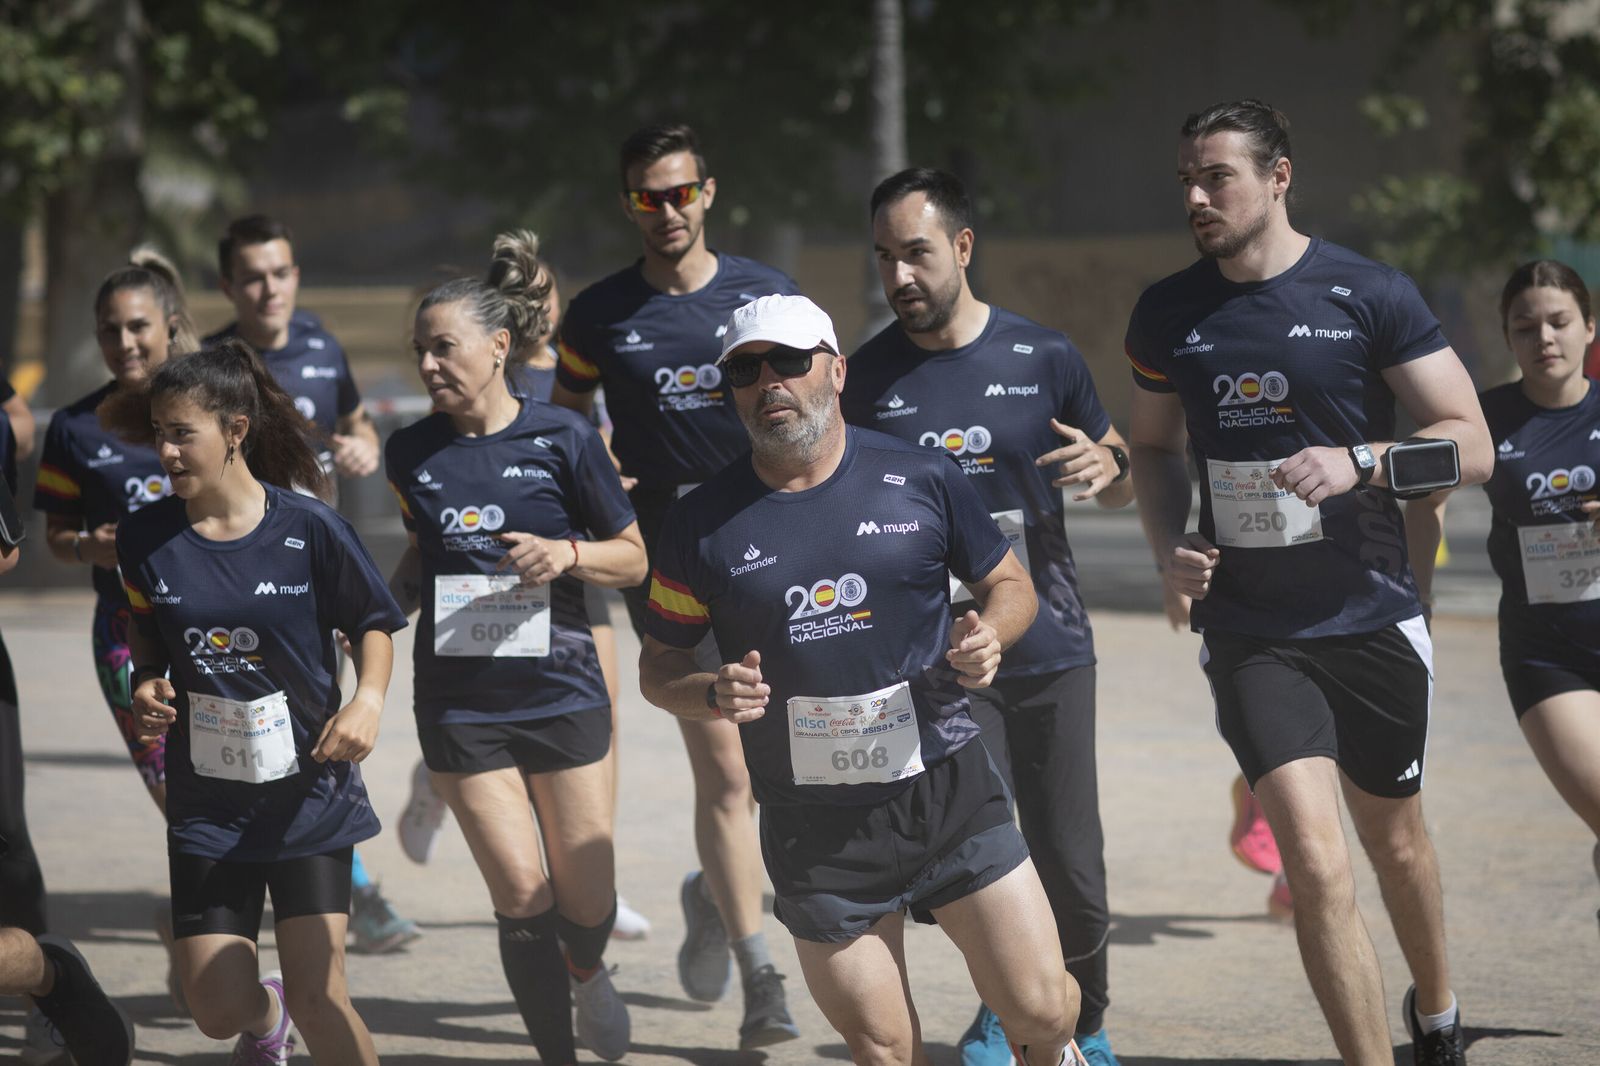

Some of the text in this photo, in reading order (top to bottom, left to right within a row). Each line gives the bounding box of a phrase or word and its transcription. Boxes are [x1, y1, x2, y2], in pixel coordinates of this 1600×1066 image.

[1315, 328, 1352, 341] mupol
[1173, 343, 1214, 357] Santander
[654, 364, 722, 394] 200
[1213, 371, 1289, 406] 200
[1008, 384, 1038, 396] mupol
[876, 406, 918, 420] Santander
[1218, 406, 1278, 419] POLICIA
[1219, 415, 1295, 429] NACIONAL
[1213, 480, 1234, 491] alsa
[1526, 465, 1596, 500] 200
[440, 504, 505, 534] 200
[883, 520, 920, 535] mupol
[1238, 511, 1287, 533] 250
[730, 555, 778, 577] Santander
[280, 582, 309, 596] mupol
[441, 593, 471, 604] alsa
[784, 573, 867, 620] 200
[470, 622, 519, 642] 609
[789, 613, 854, 635] POLICIA
[790, 620, 873, 644] NACIONAL
[184, 626, 259, 656] 200
[194, 711, 217, 726] alsa
[795, 716, 826, 729] alsa
[221, 746, 264, 768] 611
[831, 746, 889, 771] 608
